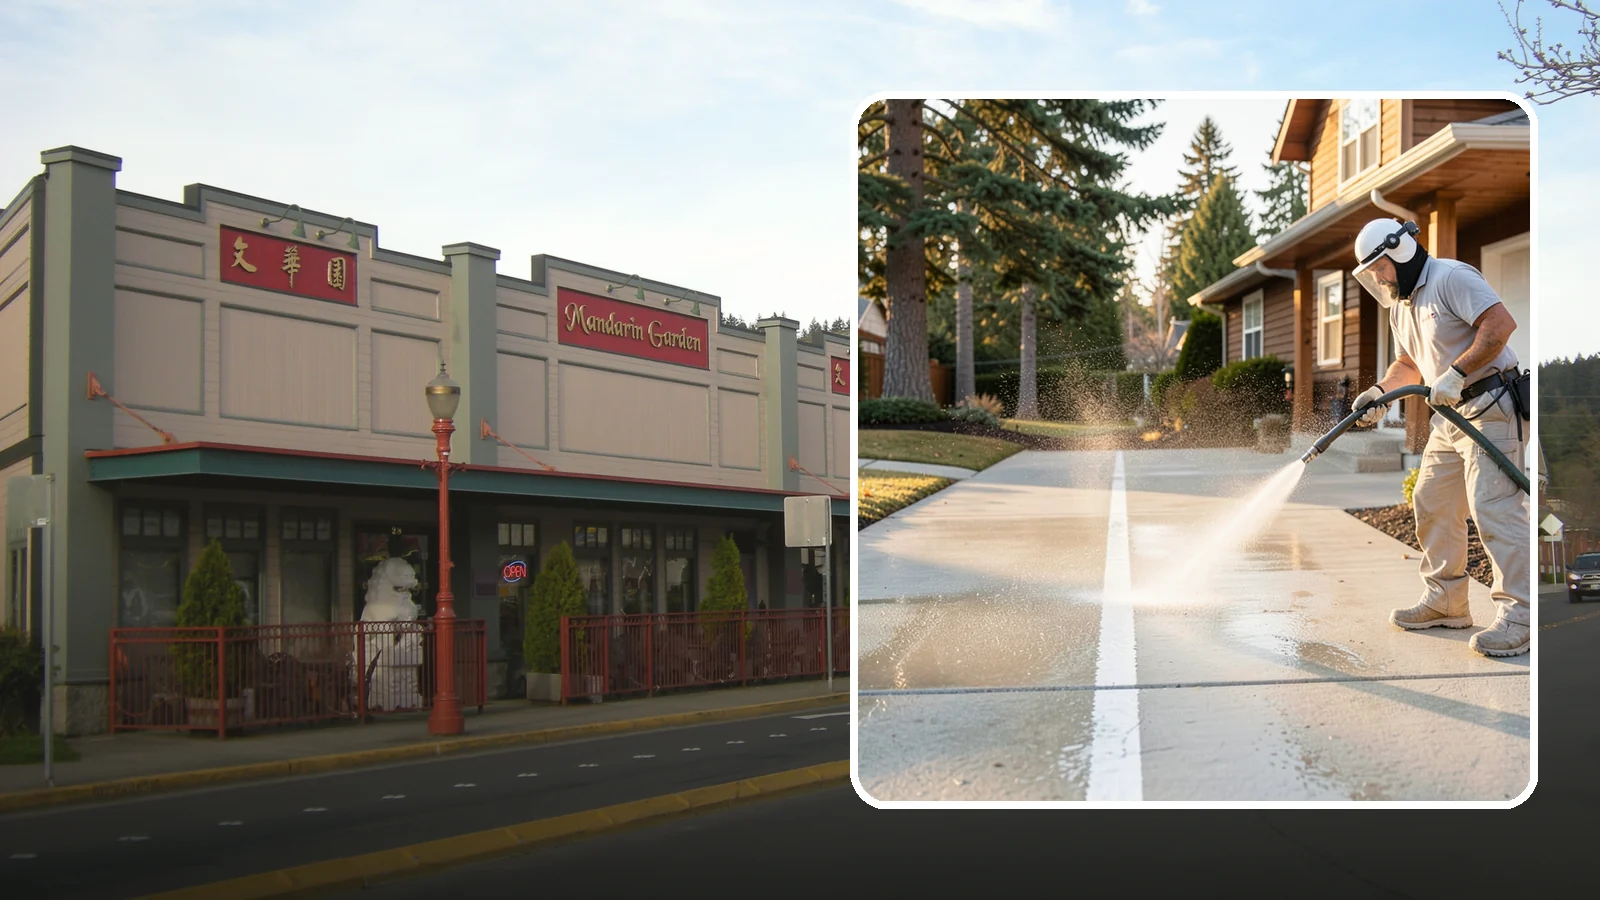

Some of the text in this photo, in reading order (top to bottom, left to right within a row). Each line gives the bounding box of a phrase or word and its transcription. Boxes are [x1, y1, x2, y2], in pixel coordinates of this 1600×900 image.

[231, 236, 346, 291] 文華園
[565, 302, 702, 352] Mandarin Garden
[503, 565, 527, 578] OPEN
